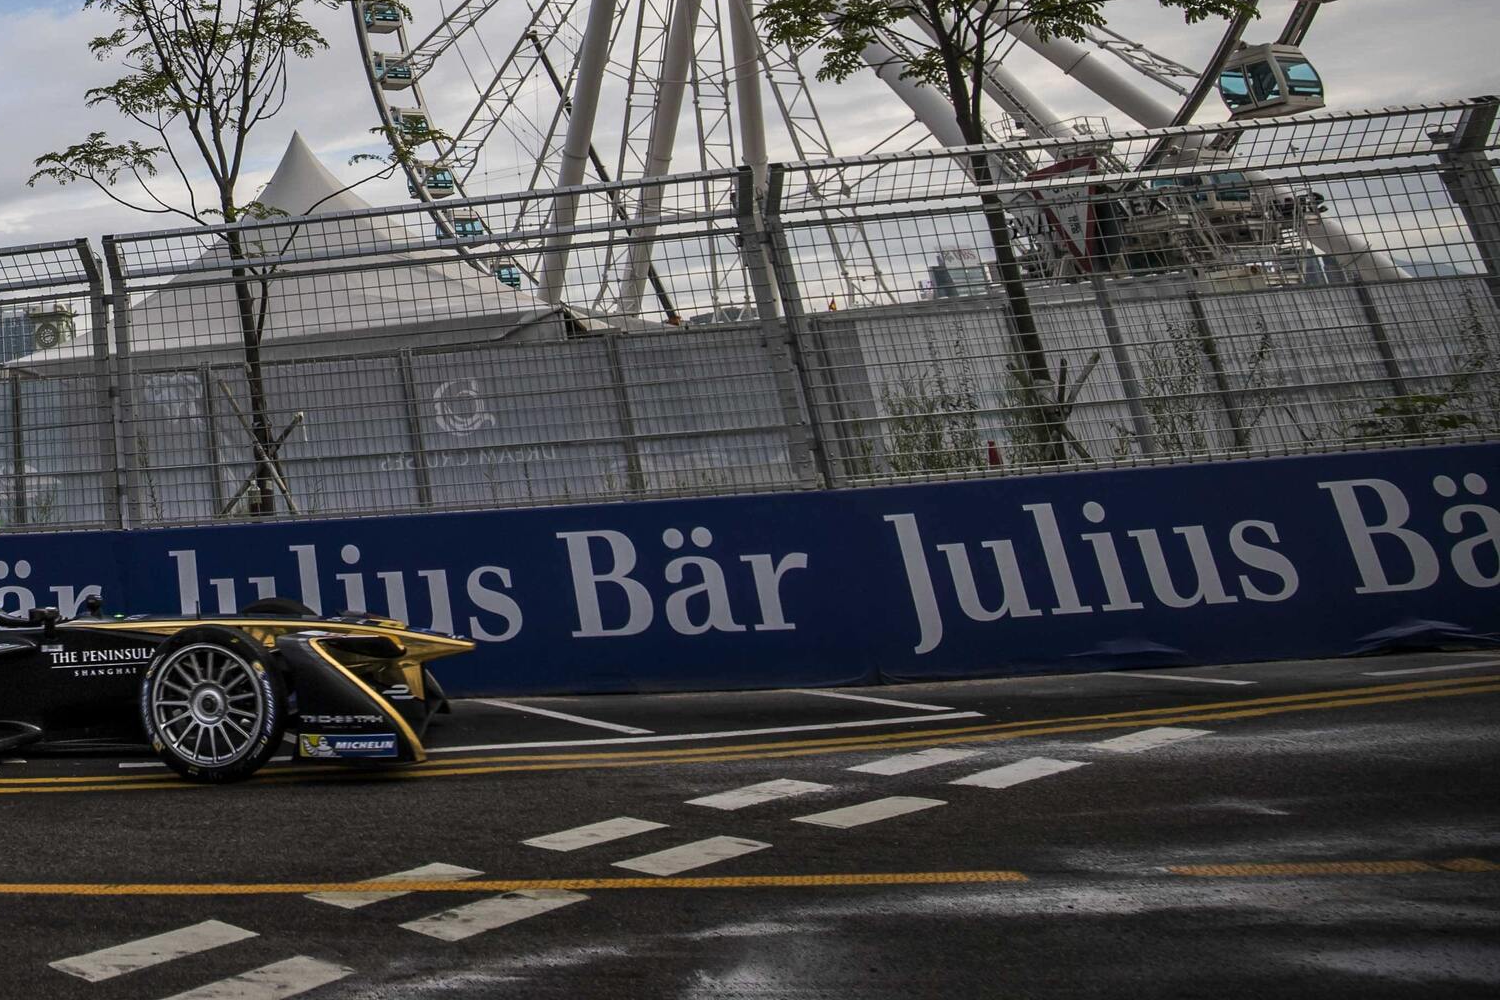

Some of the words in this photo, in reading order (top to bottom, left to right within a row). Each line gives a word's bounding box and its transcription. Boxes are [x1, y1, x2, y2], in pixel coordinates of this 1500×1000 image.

[556, 526, 808, 637] Bär
[883, 500, 1299, 654] Julius
[50, 651, 78, 664] THE
[74, 667, 137, 677] SHANGHAI
[334, 740, 395, 750] MICHELIN
